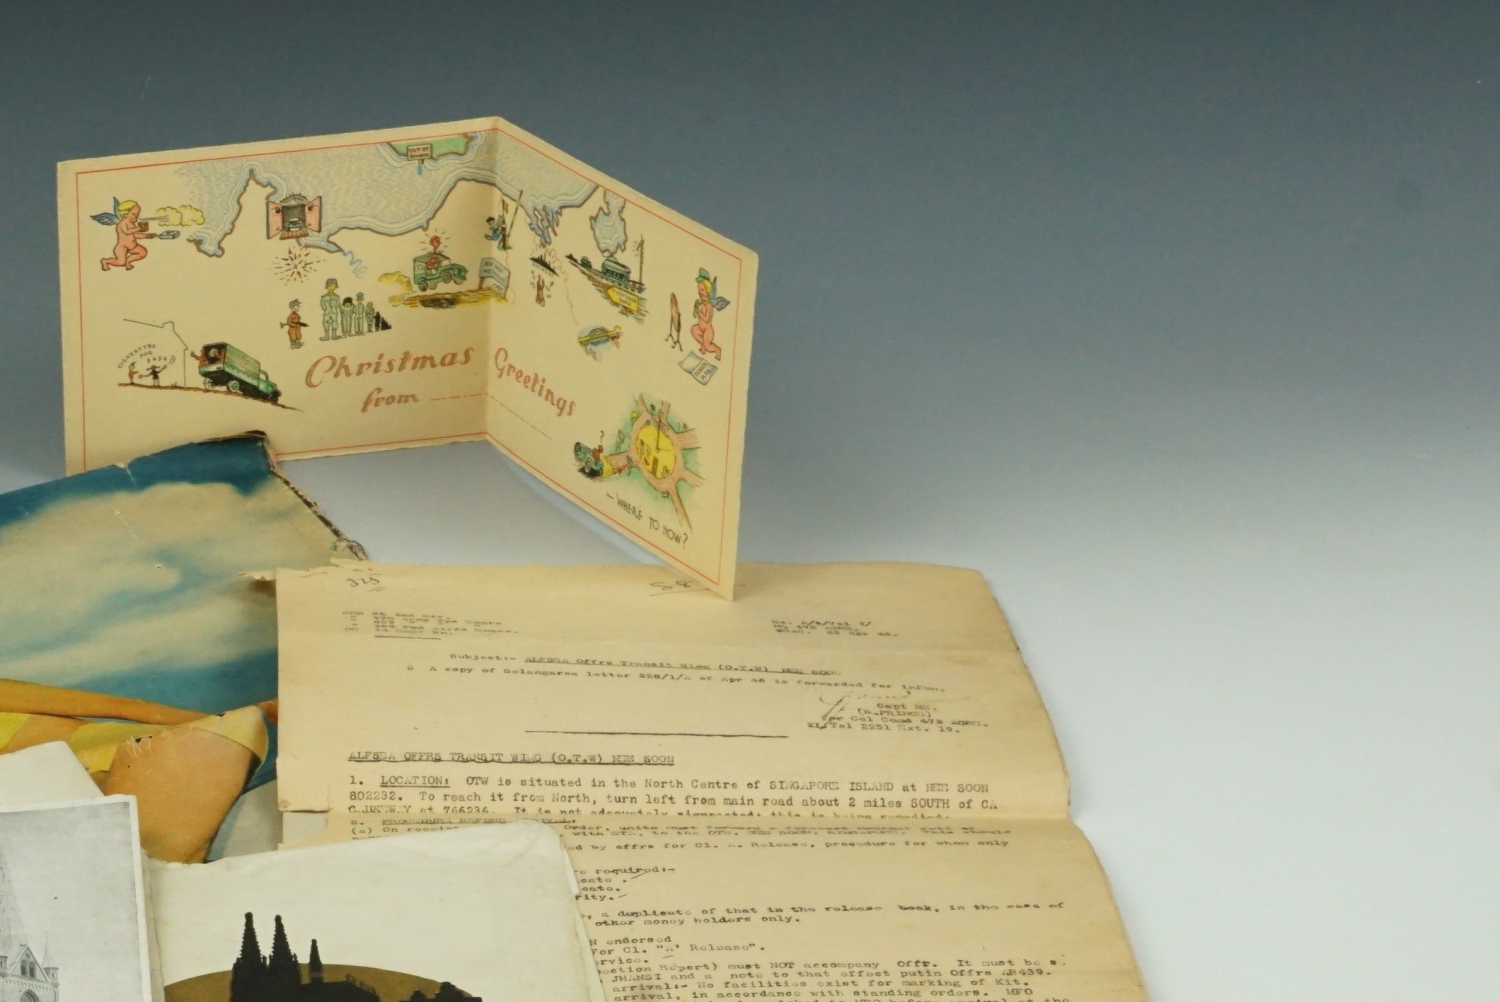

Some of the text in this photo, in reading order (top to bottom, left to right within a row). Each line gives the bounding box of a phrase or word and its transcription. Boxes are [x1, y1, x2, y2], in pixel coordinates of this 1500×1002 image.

[305, 346, 577, 417] Christmas Greetings
[361, 387, 420, 413] from
[649, 516, 660, 531] TO
[663, 525, 689, 549] NOW?
[350, 776, 364, 785] 1.
[380, 775, 450, 786] LOCATION:
[466, 776, 489, 786] OTW
[498, 777, 512, 786] is
[520, 777, 582, 787] situated
[591, 778, 606, 787] in
[613, 778, 636, 788] the
[644, 778, 683, 788] North
[691, 780, 738, 789] Centre
[746, 780, 761, 790] of
[769, 781, 840, 791] SINGAPORE
[850, 782, 894, 792] ISLAND
[902, 783, 917, 792] at
[957, 783, 989, 793] SOON
[349, 791, 974, 809] 802232. To reach it from North, turn left from main road about 2 miles SOUTH of
